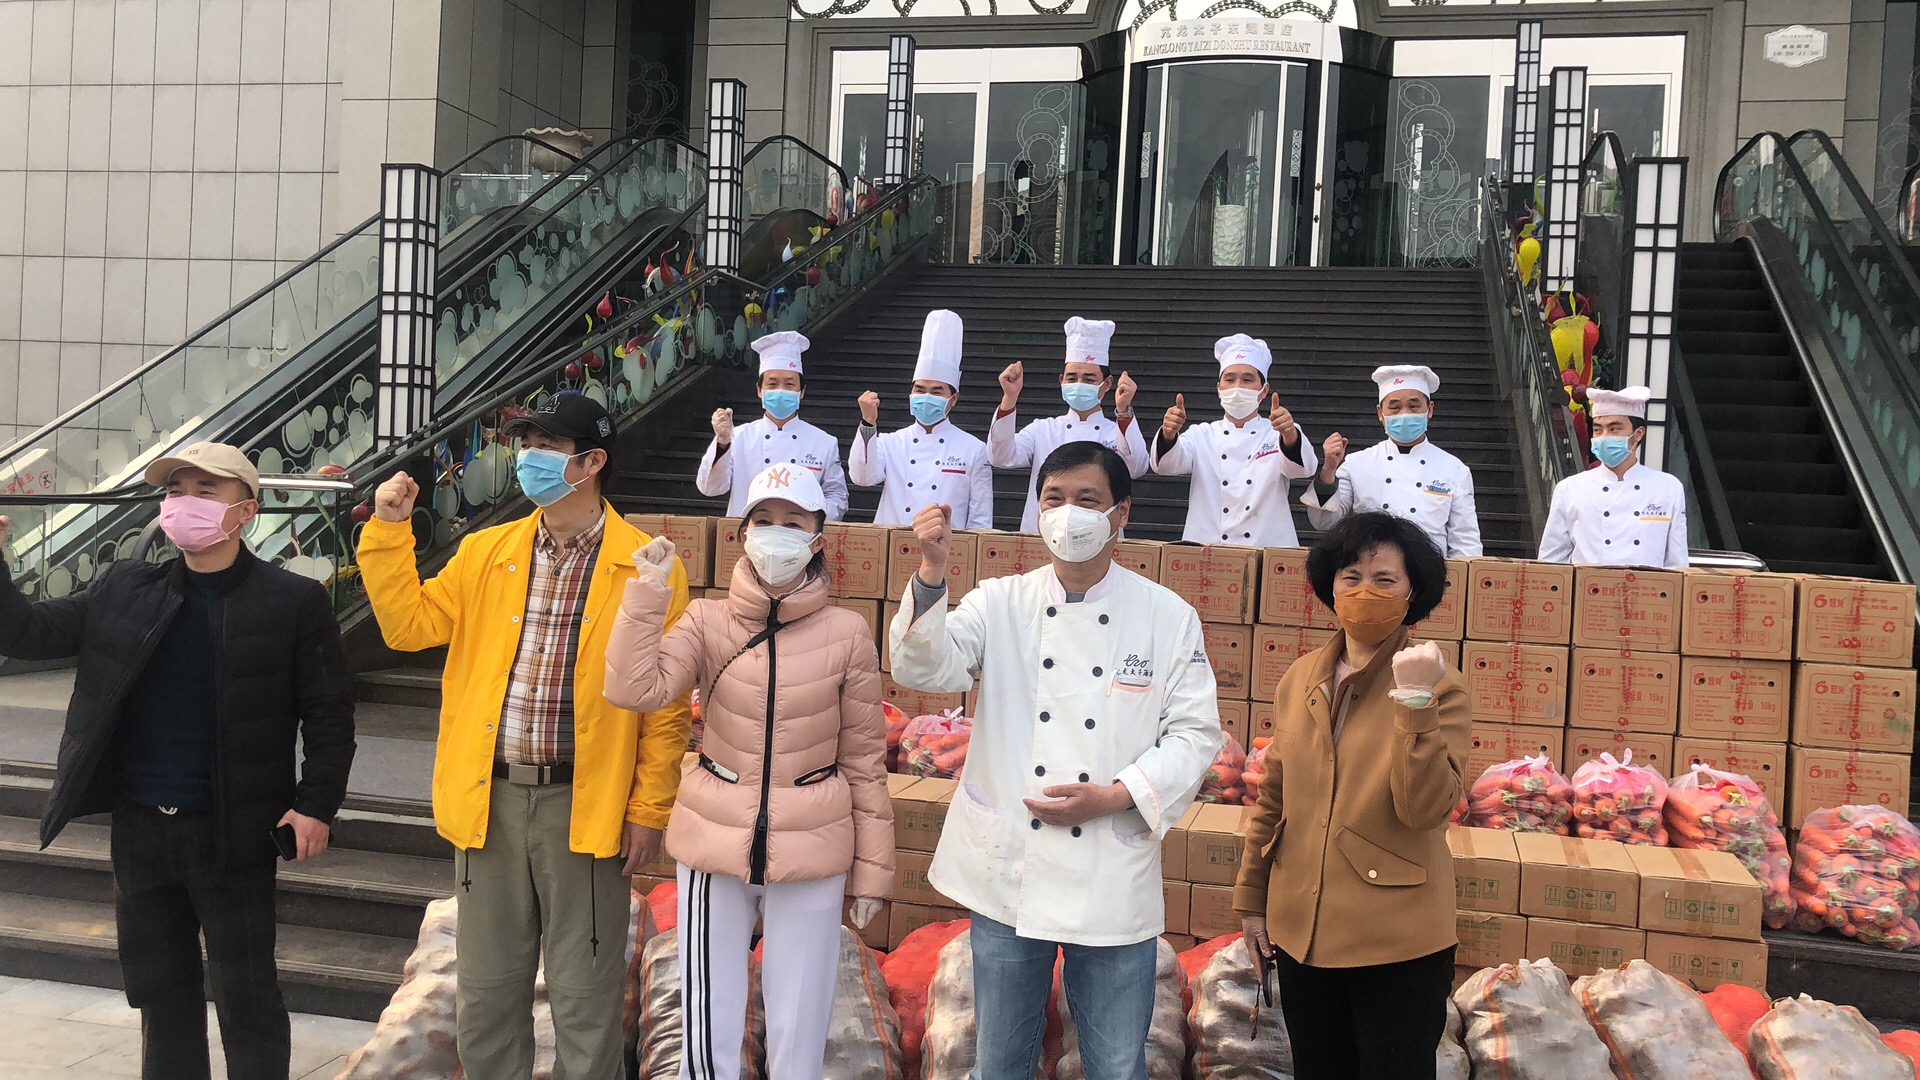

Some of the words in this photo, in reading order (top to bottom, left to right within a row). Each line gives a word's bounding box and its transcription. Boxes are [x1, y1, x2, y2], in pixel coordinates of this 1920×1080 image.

[1160, 23, 1293, 39] 亢龙太子东湖酒店
[1143, 42, 1187, 57] KANGLONG
[1188, 40, 1212, 53] TAIZI
[1213, 39, 1252, 51] DONGHU
[1252, 40, 1312, 53] RESTAURANT
[766, 467, 791, 489] NY
[1653, 612, 1668, 622] 15kg
[1224, 661, 1238, 671] 15kg
[1649, 693, 1664, 704] 15kg
[1760, 701, 1776, 712] 15kg
